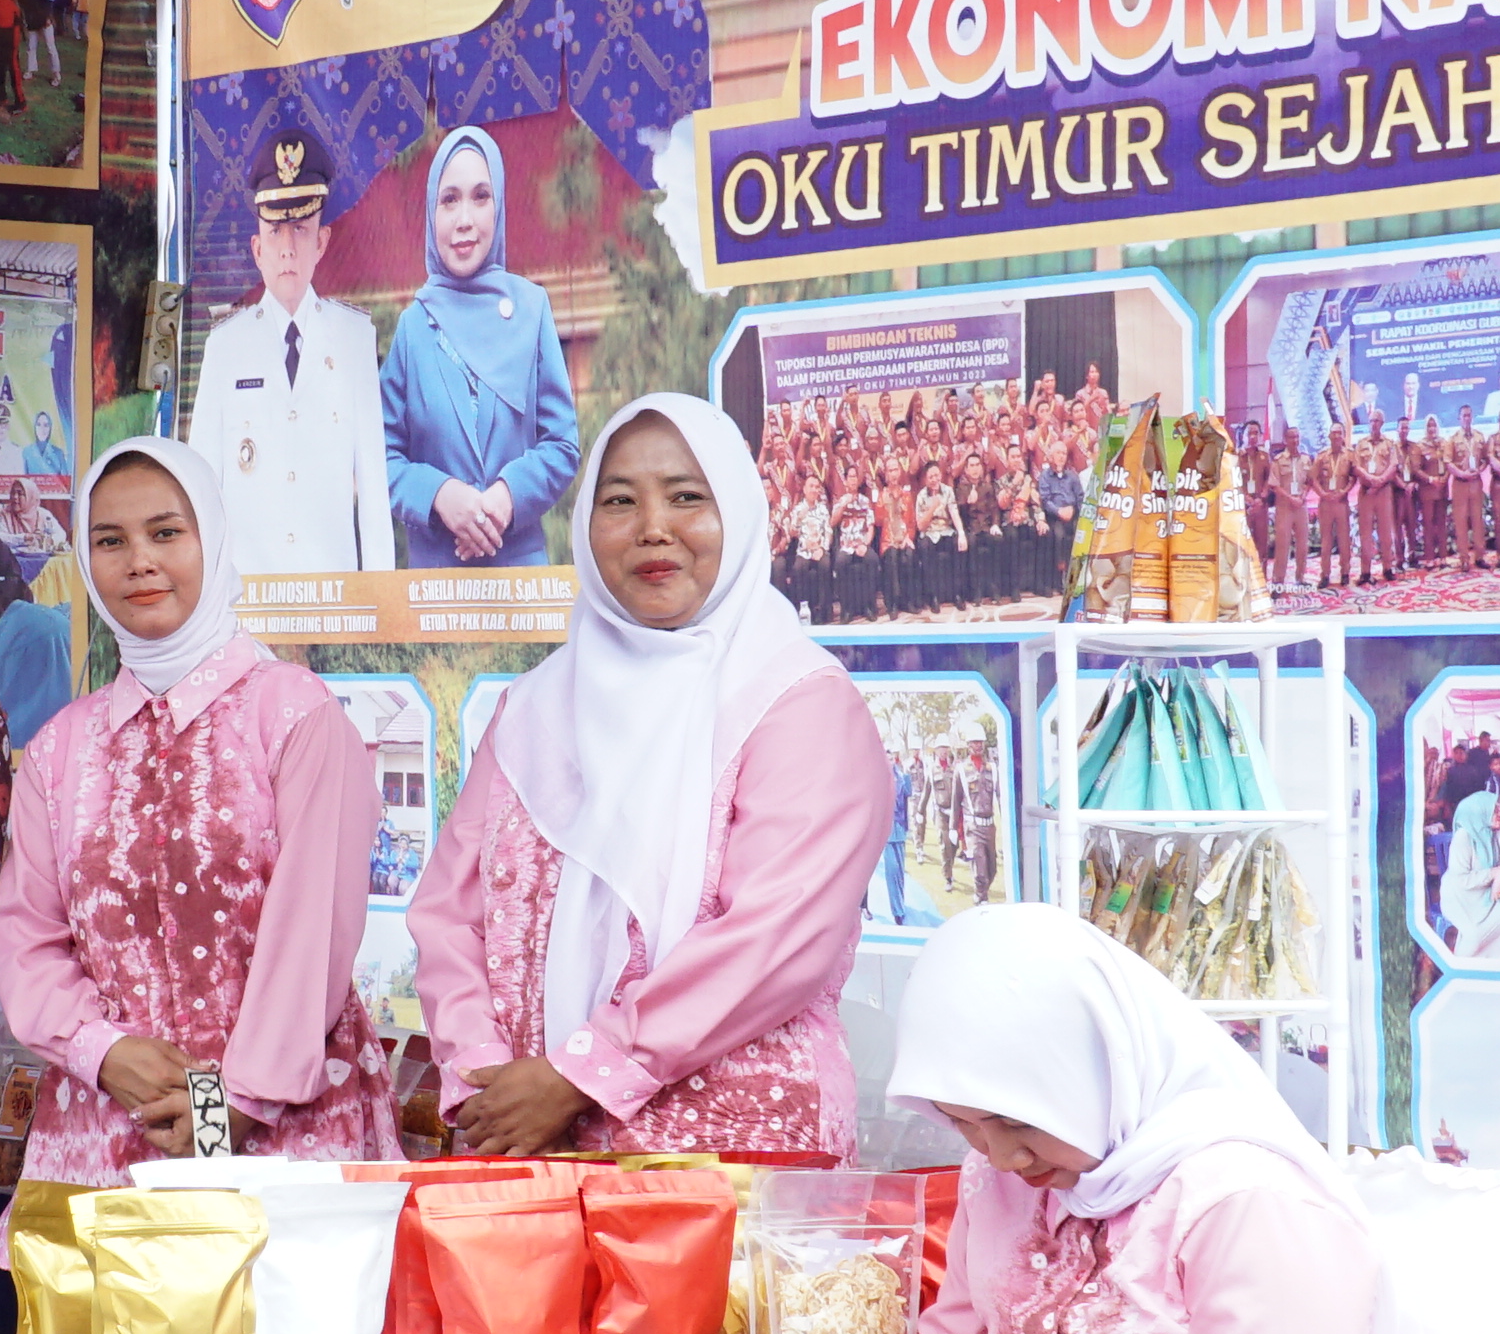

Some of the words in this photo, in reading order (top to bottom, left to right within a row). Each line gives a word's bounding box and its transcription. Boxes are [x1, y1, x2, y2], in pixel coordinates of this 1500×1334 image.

[723, 143, 881, 234] OKU
[911, 105, 1167, 215] TIMUR
[826, 329, 906, 351] BIMBINGAN
[909, 323, 957, 341] TEKNIS
[1412, 341, 1447, 354] WAKIL
[775, 357, 816, 372] TUPOKSI
[817, 353, 851, 368] BADAN
[853, 342, 954, 365] PERMUSYAWARATAN
[955, 339, 981, 354] DESA
[776, 373, 808, 388] DALAM
[984, 353, 1010, 367] DESA
[864, 379, 886, 390] OKU
[889, 375, 922, 387] TIMUR
[925, 371, 959, 383] TAHUN
[261, 580, 320, 605] LANOSIN,
[321, 579, 344, 603] M.T
[421, 580, 454, 602] SHEILA
[267, 616, 322, 634] KOMERING
[323, 615, 342, 633] ULU
[343, 614, 378, 633] TIMUR
[420, 614, 447, 632] KETUA
[448, 614, 460, 631] TP
[460, 614, 481, 631] PKK
[482, 614, 508, 632] KAB.
[510, 613, 535, 631] OKU
[536, 612, 566, 631] TIMUR
